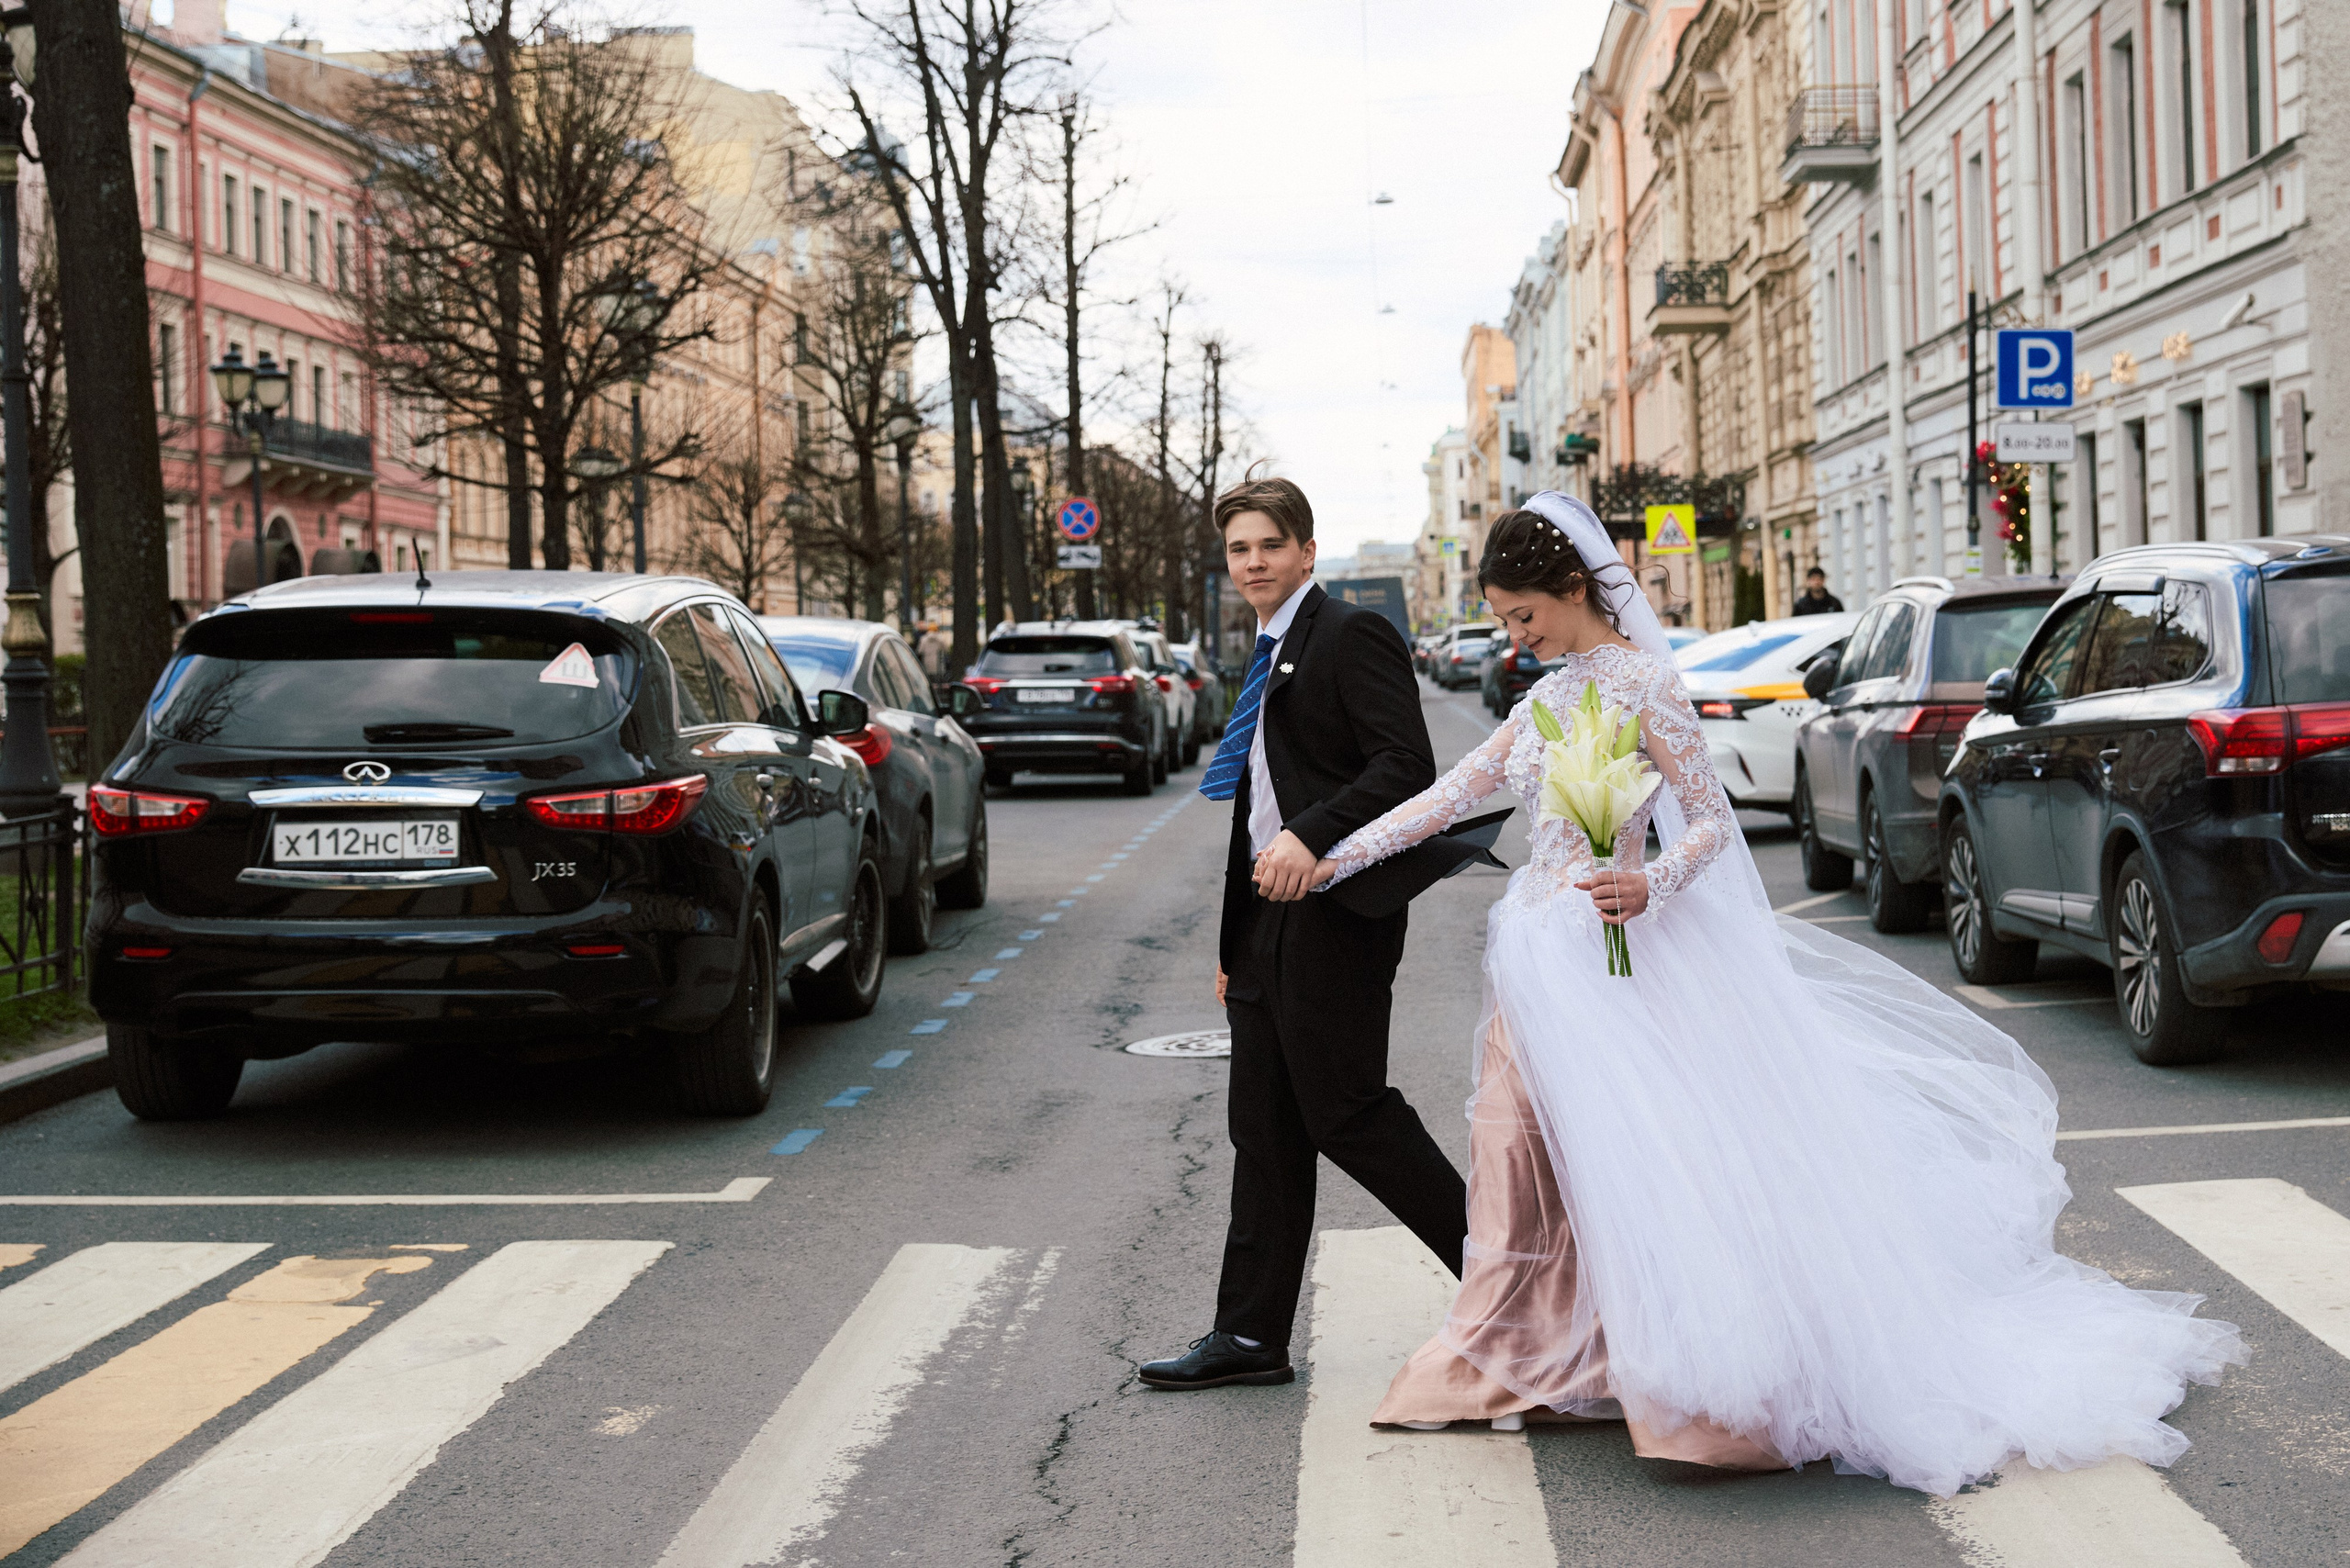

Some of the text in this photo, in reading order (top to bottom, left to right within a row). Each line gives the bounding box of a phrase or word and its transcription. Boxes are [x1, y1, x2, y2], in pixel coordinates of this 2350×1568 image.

[2018, 338, 2061, 400] P
[407, 823, 448, 846] 178
[416, 846, 438, 855] RUS
